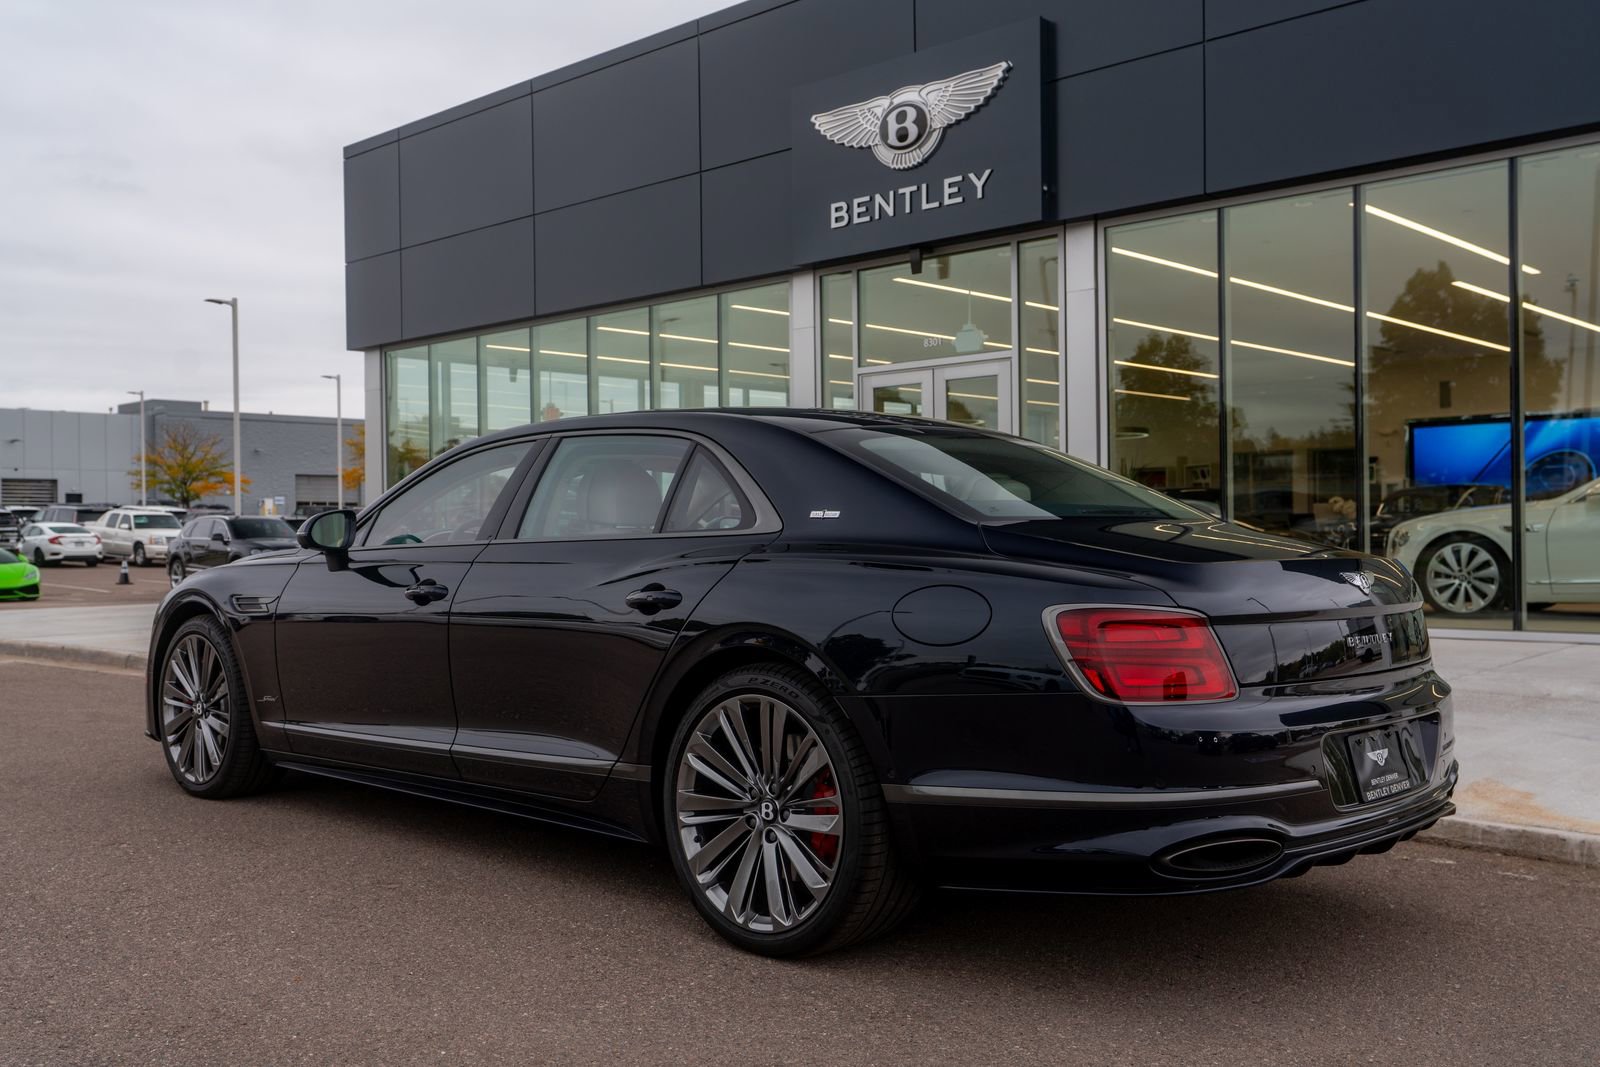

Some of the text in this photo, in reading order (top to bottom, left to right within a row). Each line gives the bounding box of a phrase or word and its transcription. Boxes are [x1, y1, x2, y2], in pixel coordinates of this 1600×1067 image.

[886, 105, 919, 147] B
[830, 169, 992, 229] BENTLEY
[923, 337, 942, 348] 8301
[1347, 632, 1392, 647] BENTLEY
[760, 678, 800, 699] ZERO
[1371, 772, 1399, 786] BENTLEY DENVER
[1366, 780, 1410, 800] BENTLEY DENVER
[760, 802, 774, 821] B
